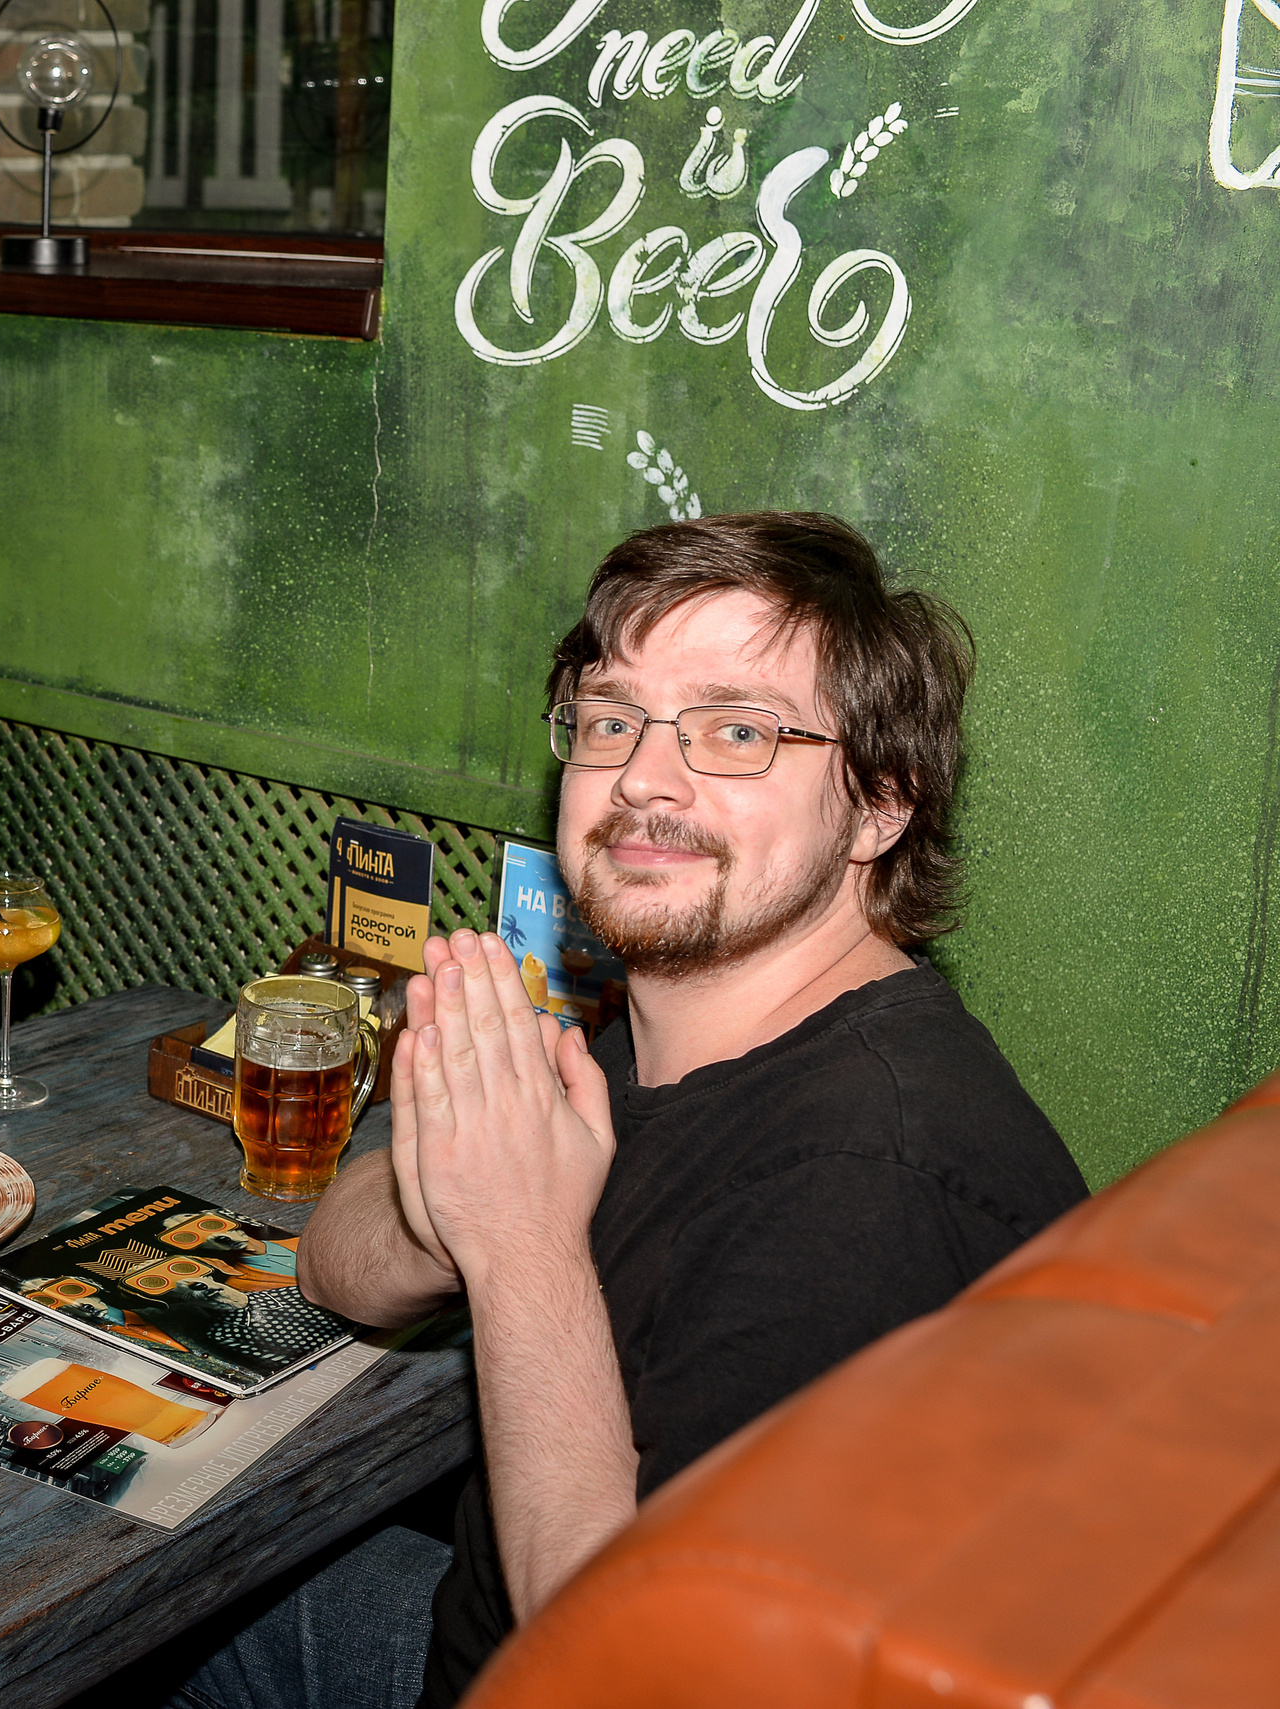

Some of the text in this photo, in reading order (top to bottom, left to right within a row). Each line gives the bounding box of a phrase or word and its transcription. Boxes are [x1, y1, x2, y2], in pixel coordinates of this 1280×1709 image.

[587, 0, 820, 107] need
[678, 105, 749, 199] is
[454, 93, 913, 412] Beer
[347, 842, 395, 878] ПИНТА
[517, 885, 547, 915] НА
[351, 914, 416, 939] ДОРОГОЙ
[351, 926, 391, 947] ГОСТЬ
[98, 1196, 182, 1236] menu
[67, 1232, 103, 1249] ПИНТА
[61, 1378, 101, 1409] Барное
[143, 1460, 238, 1522] ЧРЕЗМЕРНОЕ
[225, 1394, 311, 1464] УПОТРЕБЛЕНИЕ
[298, 1371, 348, 1407] ПИВА
